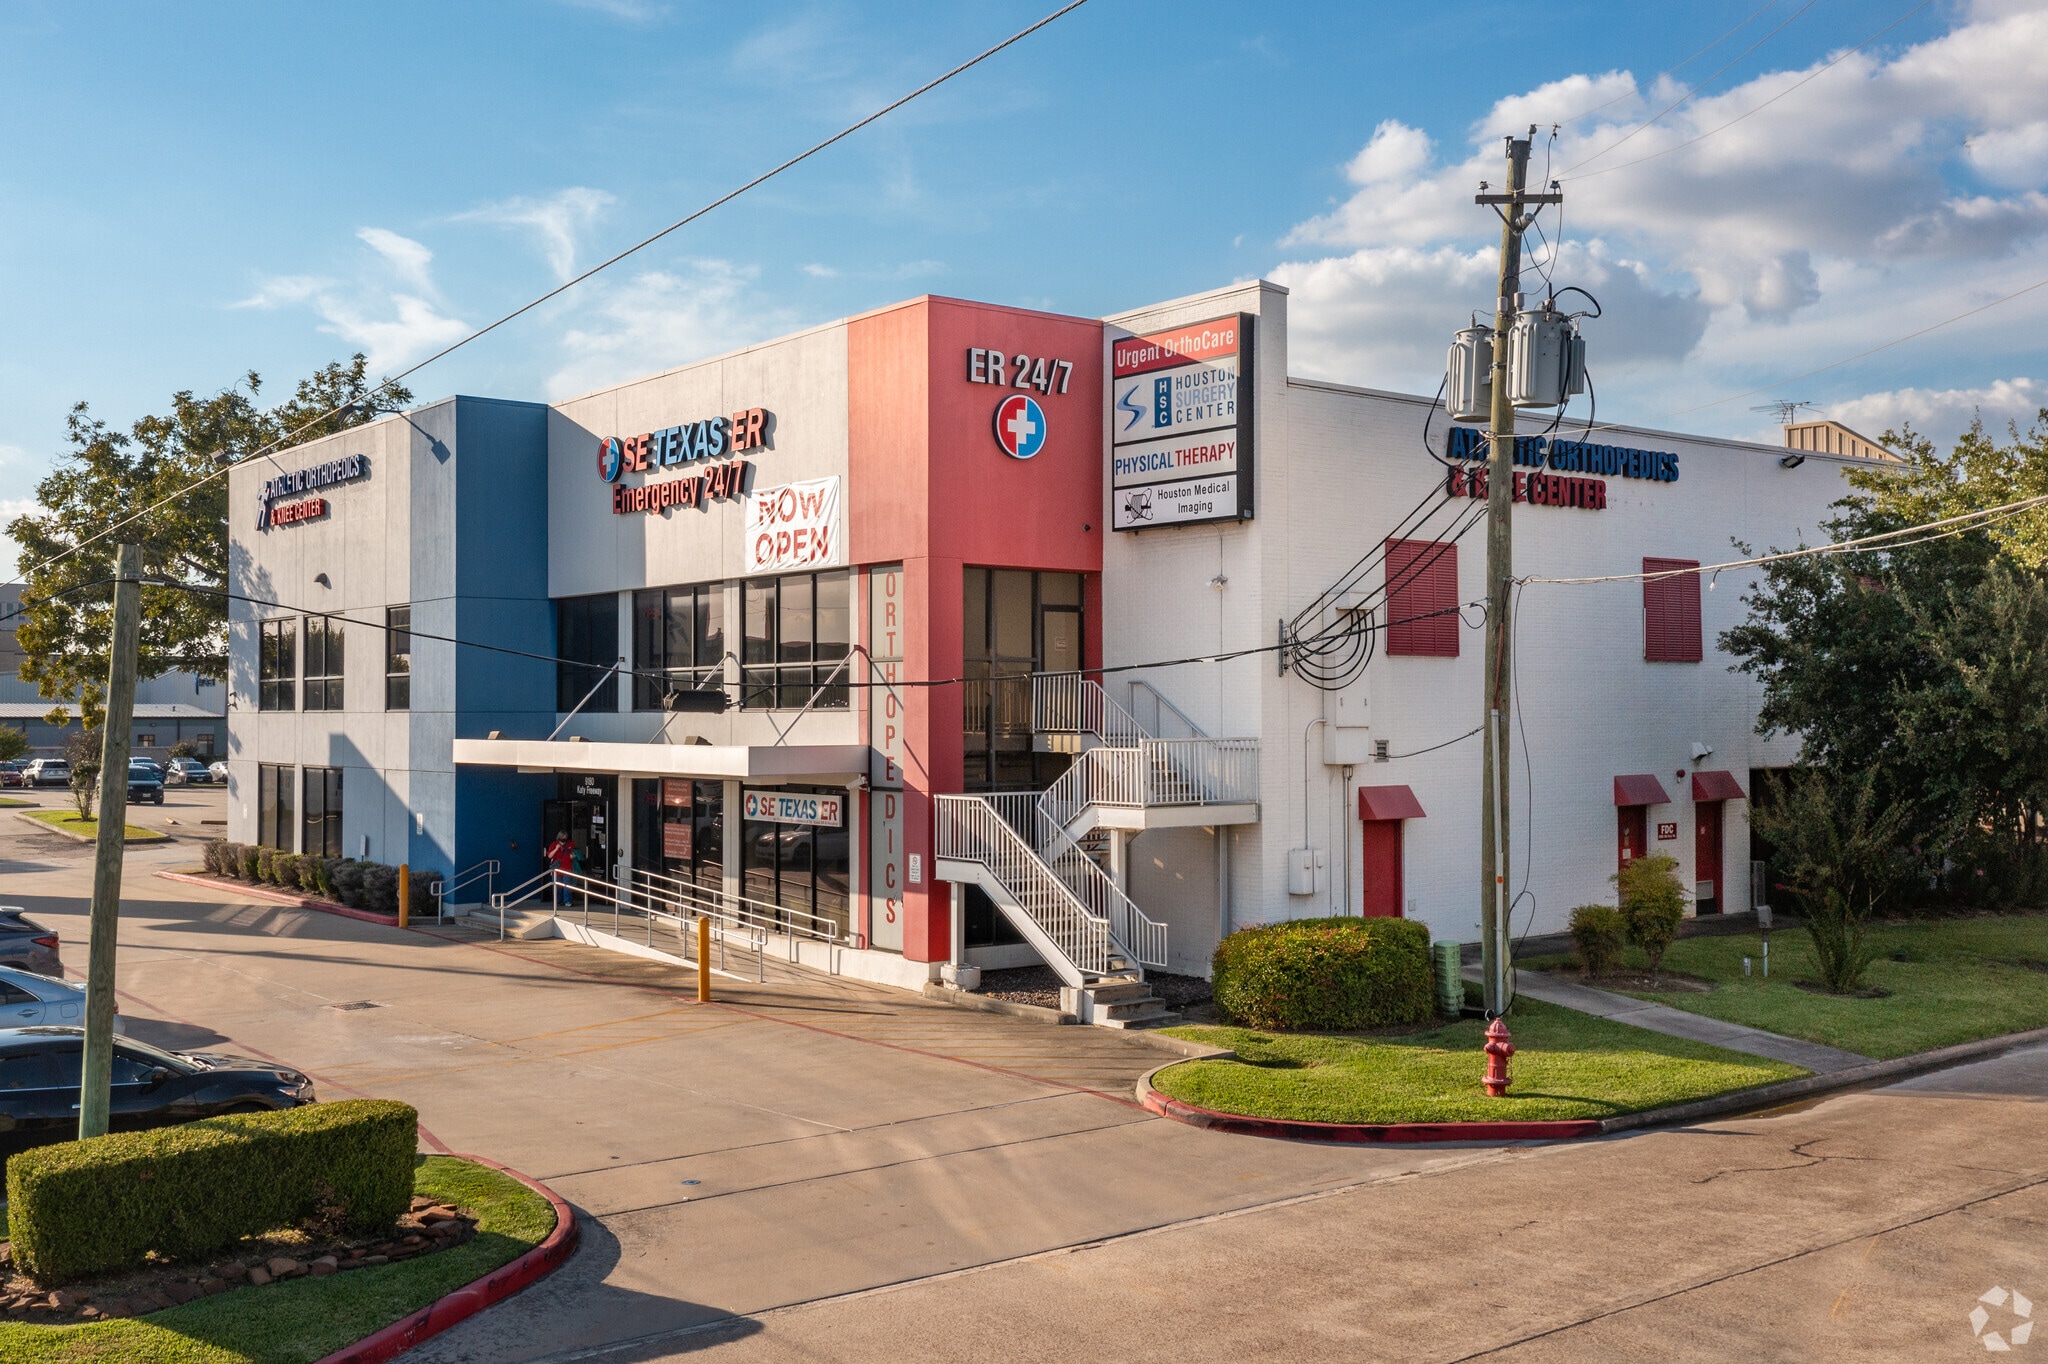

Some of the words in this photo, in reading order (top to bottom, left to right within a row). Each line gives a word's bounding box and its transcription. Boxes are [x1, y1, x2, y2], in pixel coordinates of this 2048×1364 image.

[1117, 344, 1160, 369] Urgent
[1164, 329, 1235, 359] OrthoCare
[970, 347, 1006, 386] ER
[1013, 354, 1074, 396] 24/7
[1176, 366, 1236, 391] HOUSTON
[1159, 380, 1168, 424] HSC
[1176, 382, 1236, 408] SURGERY
[1176, 401, 1235, 424] CENTER
[622, 432, 651, 473] SE
[654, 416, 725, 467] TEXAS
[731, 407, 765, 452] ER
[1115, 450, 1175, 477] PHYSICAL
[1175, 441, 1236, 468] THERAPY
[270, 468, 304, 499] ATHLETIC
[305, 453, 361, 489] ORTHOPEDICS
[1553, 438, 1680, 483] ORTHOPEDICS
[613, 475, 700, 515] Emergency
[703, 460, 745, 500] 24/7
[1157, 486, 1192, 501] Houston
[1194, 480, 1230, 496] Medical
[1451, 464, 1468, 497] &
[1532, 471, 1607, 510] CENTER
[270, 508, 276, 526] &
[277, 504, 294, 524] KNEE
[295, 498, 322, 521] CENTER
[759, 487, 826, 527] NOW
[1177, 500, 1214, 516] Imaging
[755, 525, 829, 566] OPEN
[885, 571, 897, 925] ORTHOPEDICS
[577, 785, 585, 796] Katy
[586, 786, 602, 796] Freeway
[585, 776, 595, 785] 9180
[760, 796, 776, 817] SE
[779, 798, 817, 820] TEXAS
[821, 800, 838, 821] ER
[1661, 824, 1674, 834] FDC
